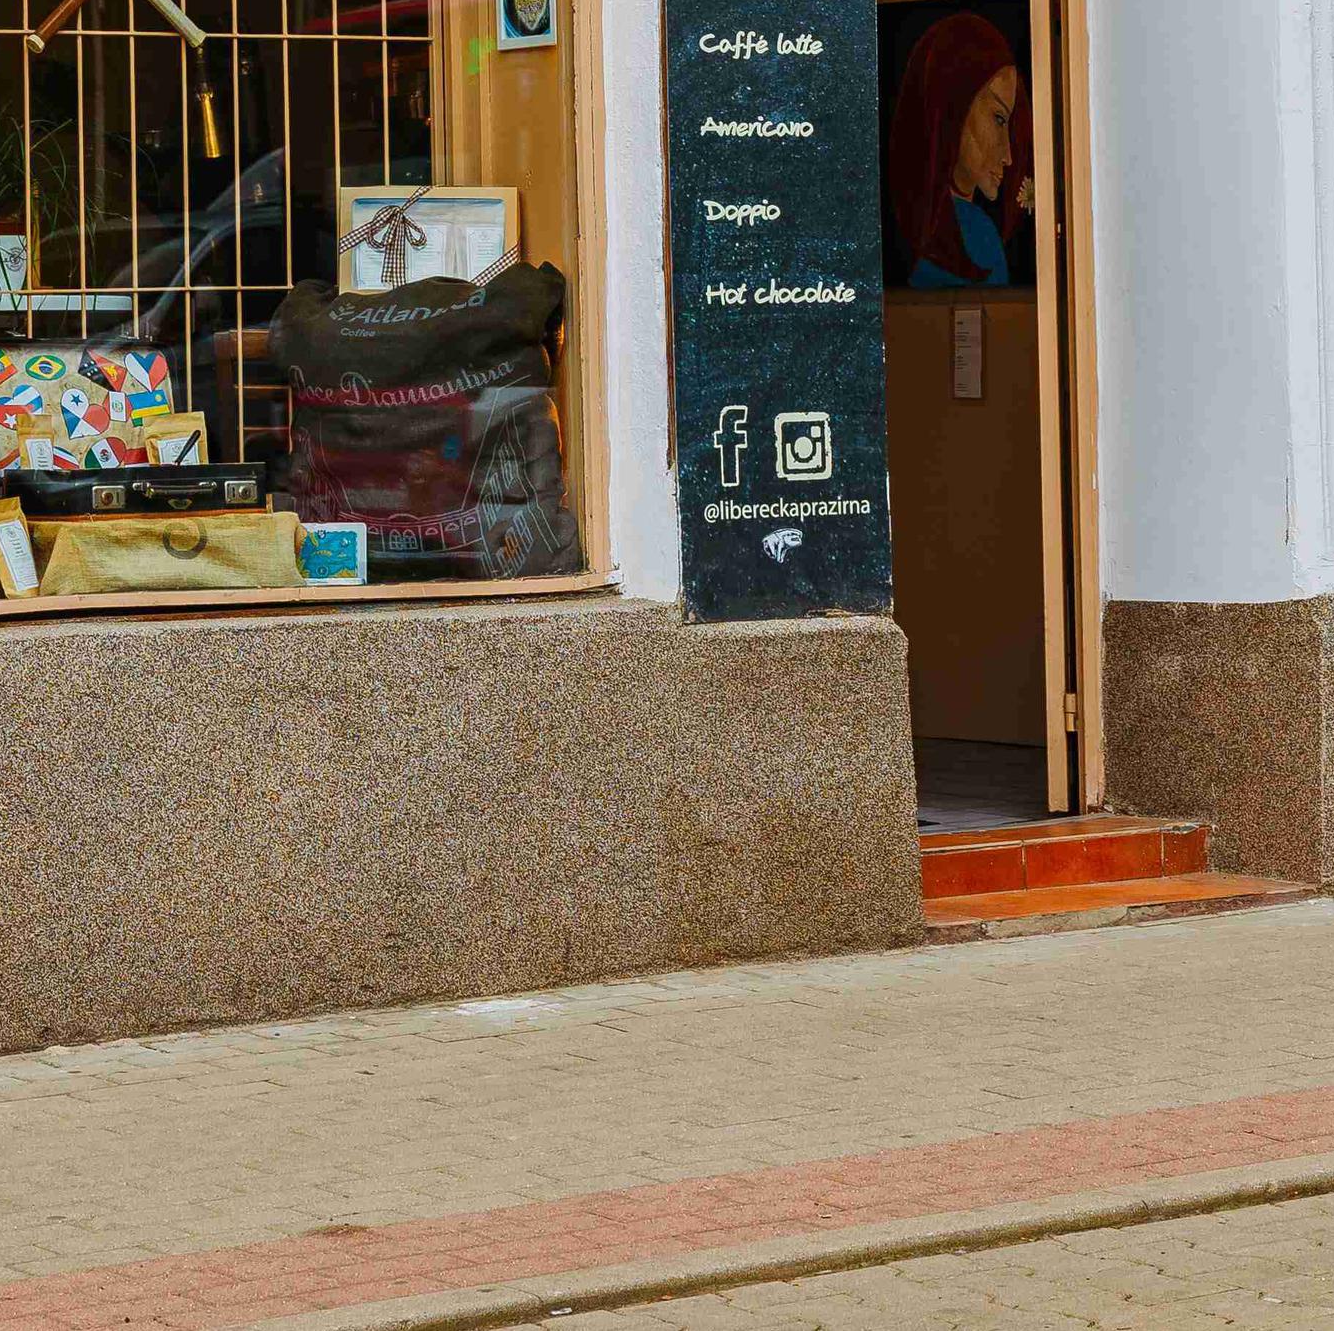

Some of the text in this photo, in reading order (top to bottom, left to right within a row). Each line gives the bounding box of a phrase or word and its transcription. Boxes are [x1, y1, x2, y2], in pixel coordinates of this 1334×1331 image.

[776, 32, 824, 56] latte
[700, 115, 814, 138] Americano
[703, 198, 781, 226] Doppio
[705, 277, 857, 306] Hot chocolate
[703, 495, 871, 524] @libereckaprazirna
